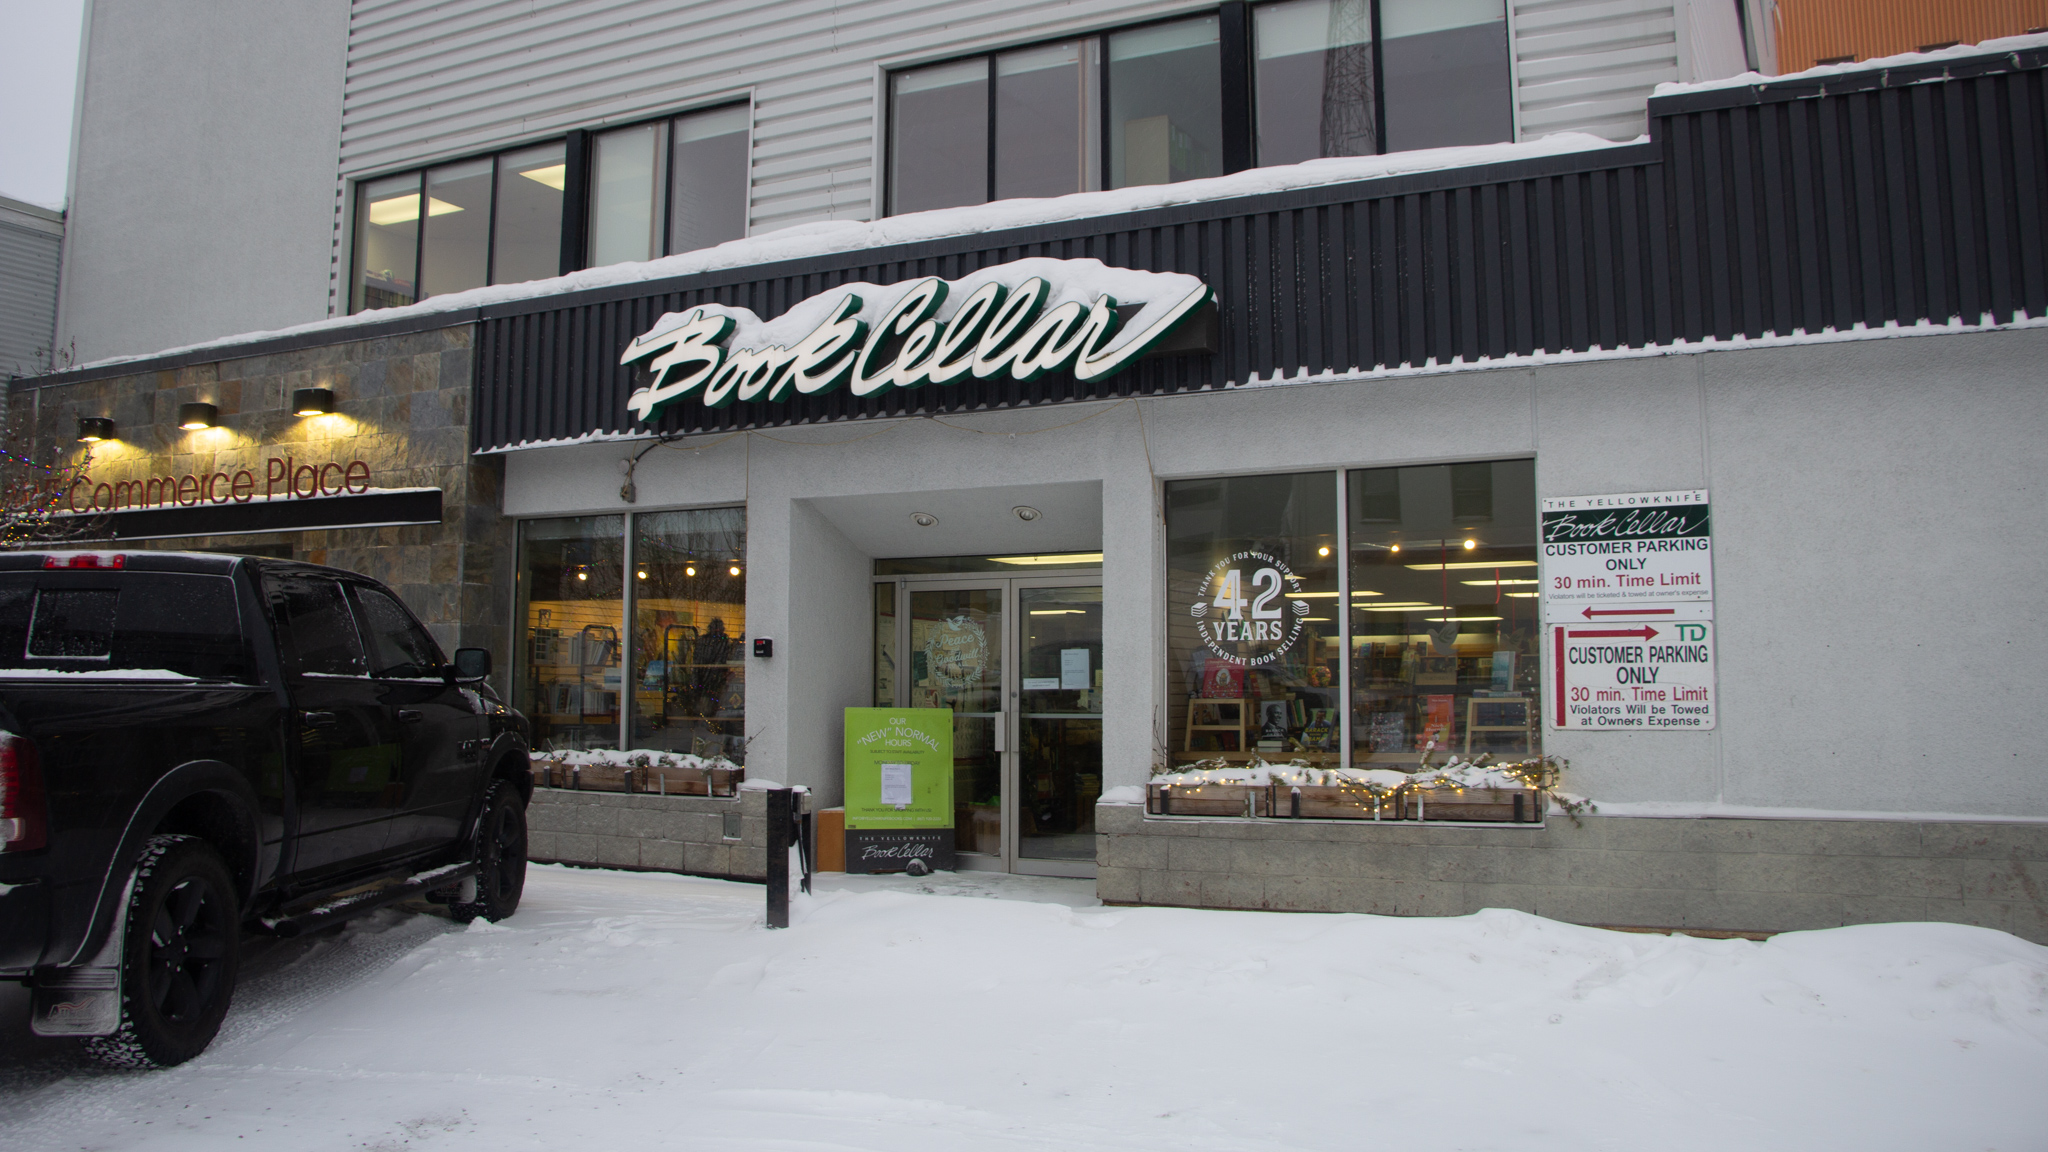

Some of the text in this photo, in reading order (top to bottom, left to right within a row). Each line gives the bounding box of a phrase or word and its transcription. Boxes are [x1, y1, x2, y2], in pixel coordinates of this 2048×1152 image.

[620, 276, 1216, 421] Book Cellar
[70, 469, 255, 514] Commerce
[267, 457, 371, 501] Place
[1548, 494, 1702, 508] THE YELLOWKNIFE
[1542, 509, 1709, 541] Book Cellar
[1545, 538, 1709, 556] CUSTOMER PARKING
[1605, 558, 1647, 571] ONLY
[1198, 551, 1302, 597] THANK YOU FOR YOUR SUPPORT
[1554, 572, 1701, 589] 30 min. Time Limit
[1213, 567, 1282, 620] 42
[1656, 589, 1680, 597] owner's
[1682, 589, 1709, 597] expense
[1213, 621, 1282, 641] YEARS
[1674, 624, 1707, 641] TD
[935, 634, 974, 648] Peace
[1196, 617, 1304, 666] INDEPENDENT BOOK SELLING
[935, 648, 979, 666] Goodwill
[1569, 645, 1708, 664] CUSTOMER PARKING
[1616, 666, 1659, 684] ONLY
[1571, 687, 1708, 701] 30 min. Time Limit
[1570, 704, 1709, 714] Violators Will be Towed
[889, 717, 906, 725] OUR
[1581, 716, 1700, 727] at Owners Expense
[885, 739, 911, 747] HOURS
[895, 727, 940, 752] NORMAL
[862, 843, 934, 860] Book Cellar
